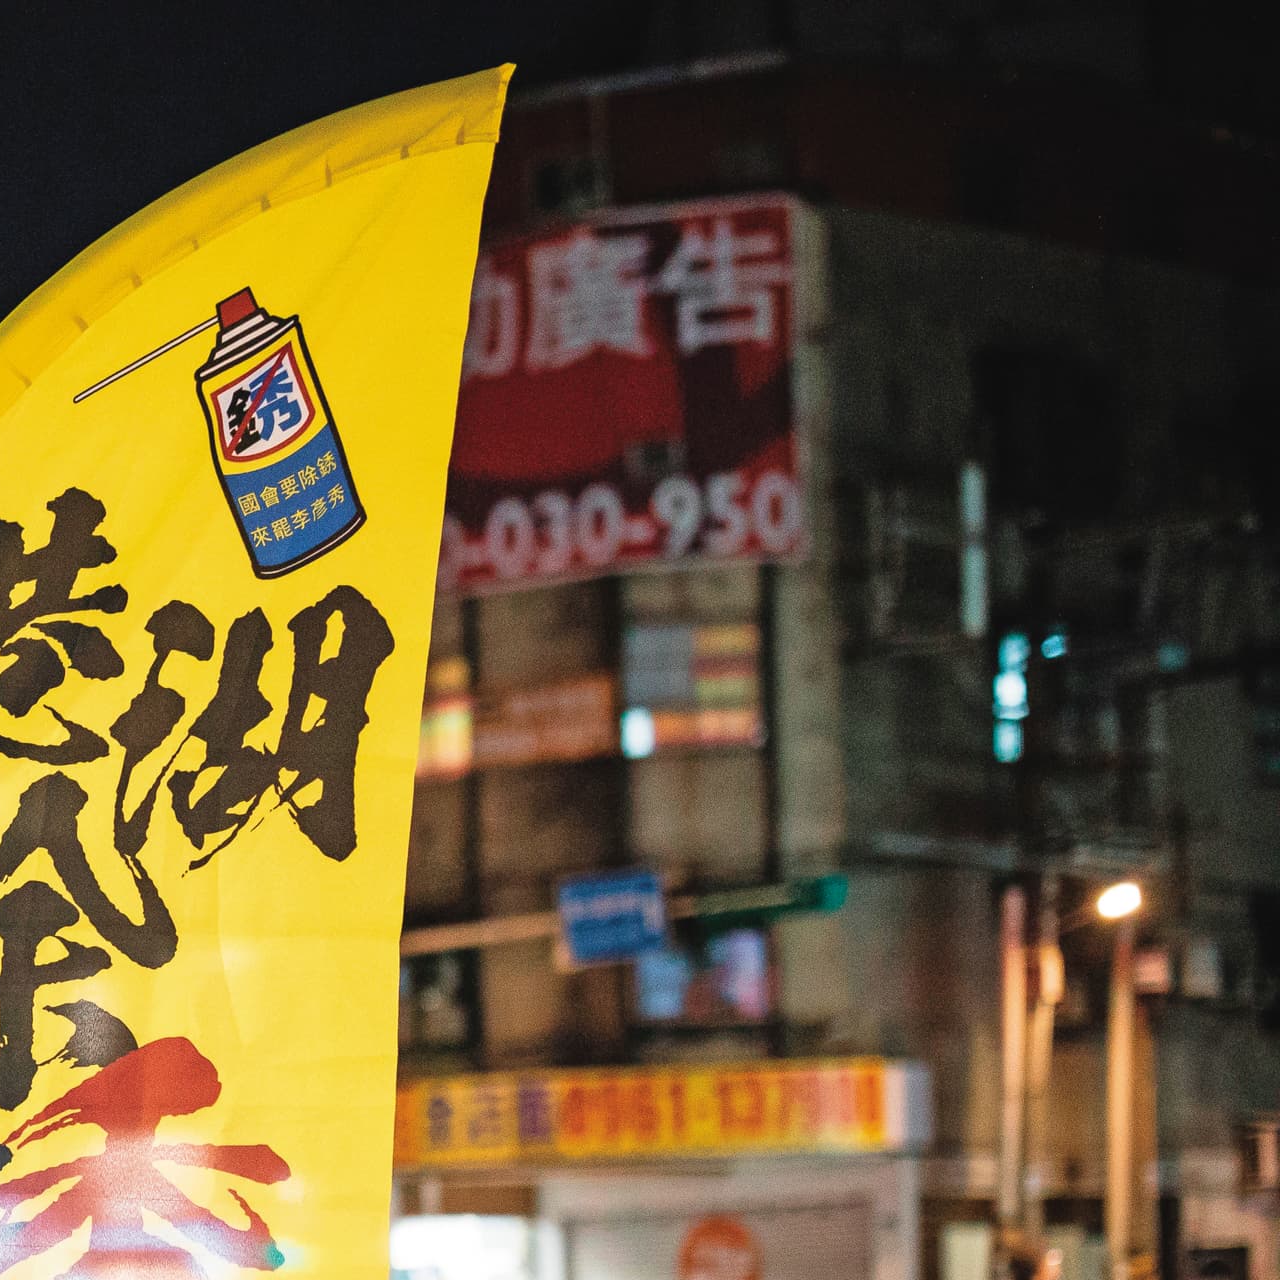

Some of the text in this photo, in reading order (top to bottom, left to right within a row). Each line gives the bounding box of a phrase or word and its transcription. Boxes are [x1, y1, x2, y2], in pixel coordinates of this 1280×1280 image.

[237, 450, 337, 517] 國會要除銹
[250, 483, 345, 548] 來罷李彥秀
